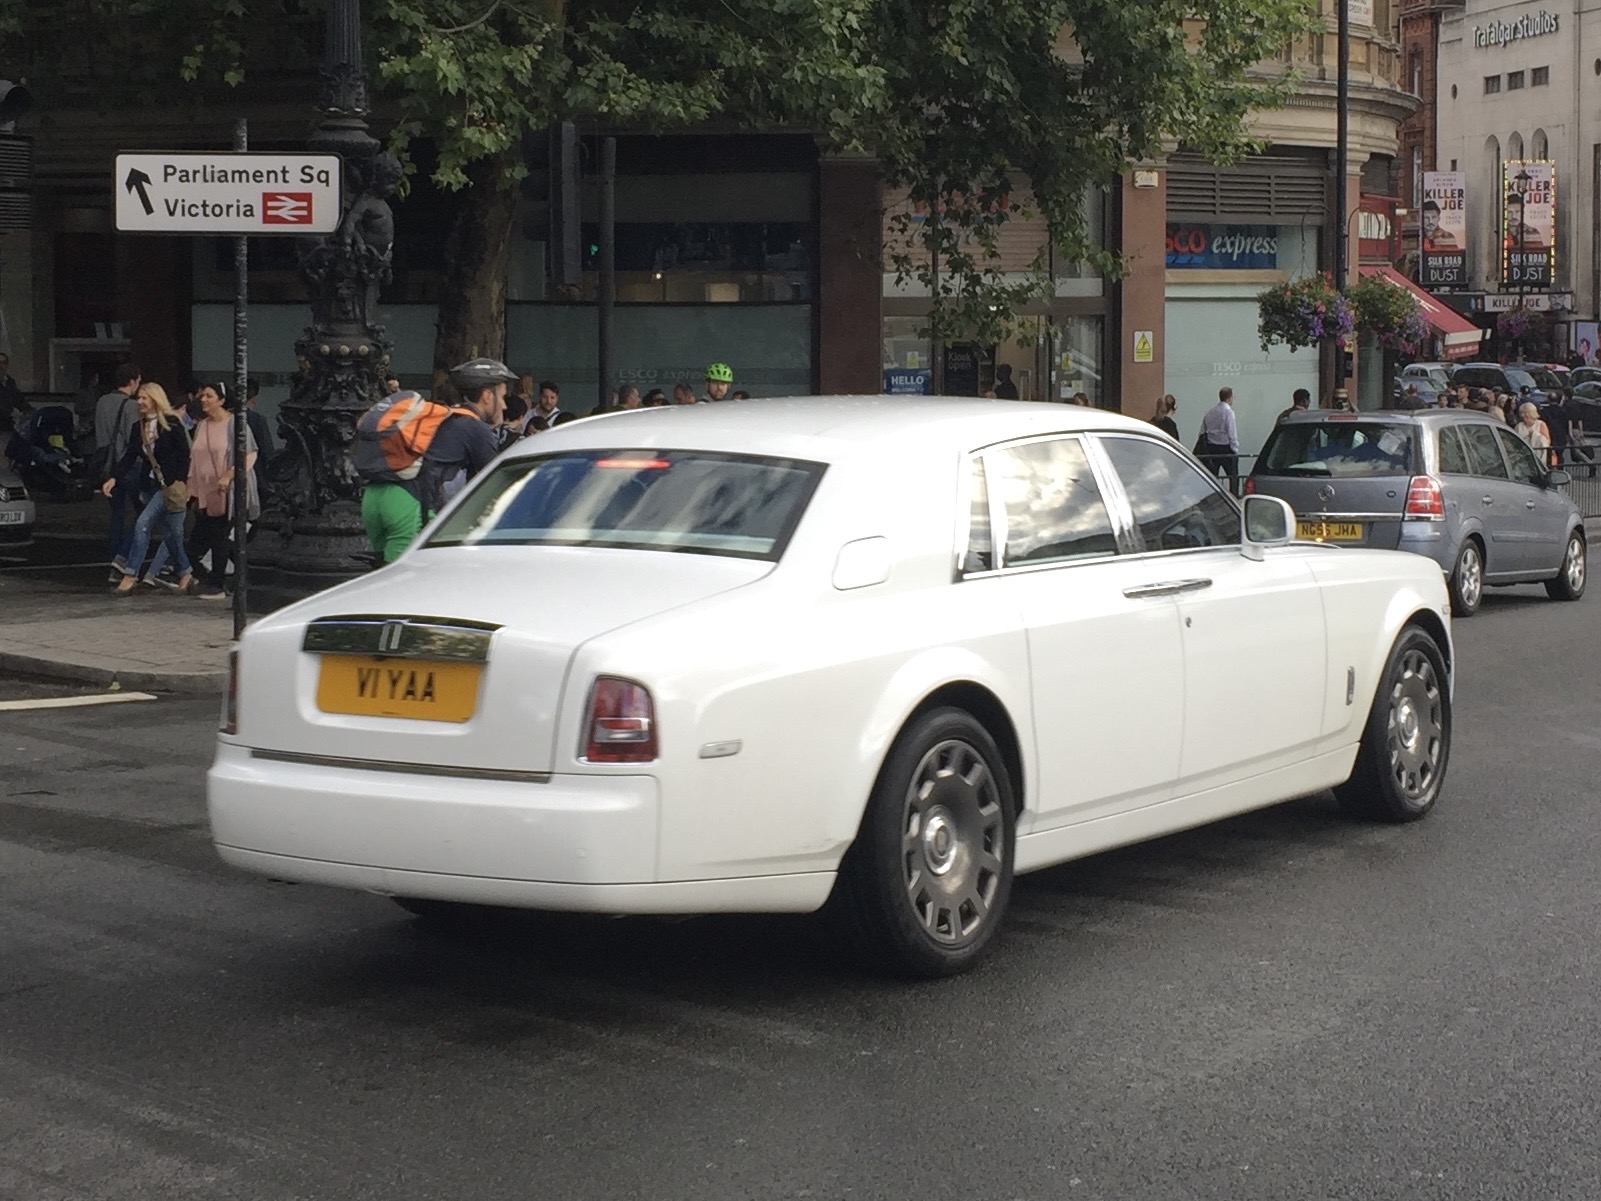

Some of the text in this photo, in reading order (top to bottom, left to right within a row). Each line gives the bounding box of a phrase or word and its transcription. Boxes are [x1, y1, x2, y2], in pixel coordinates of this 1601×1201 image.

[1472, 10, 1558, 48] Trafalgar Studios
[163, 164, 330, 187] Parliament Sq
[1424, 188, 1464, 199] KILLER
[1526, 192, 1550, 204] JOE
[164, 198, 255, 218] Victoria
[1441, 199, 1464, 211] JOE
[1212, 232, 1279, 262] express
[1444, 256, 1463, 266] ROAD
[1430, 268, 1459, 282] DUST
[1524, 298, 1541, 308] JOE
[1211, 362, 1242, 372] TESCO
[891, 375, 925, 386] HELLO
[1334, 524, 1357, 536] JHA
[387, 669, 437, 702] YAA
